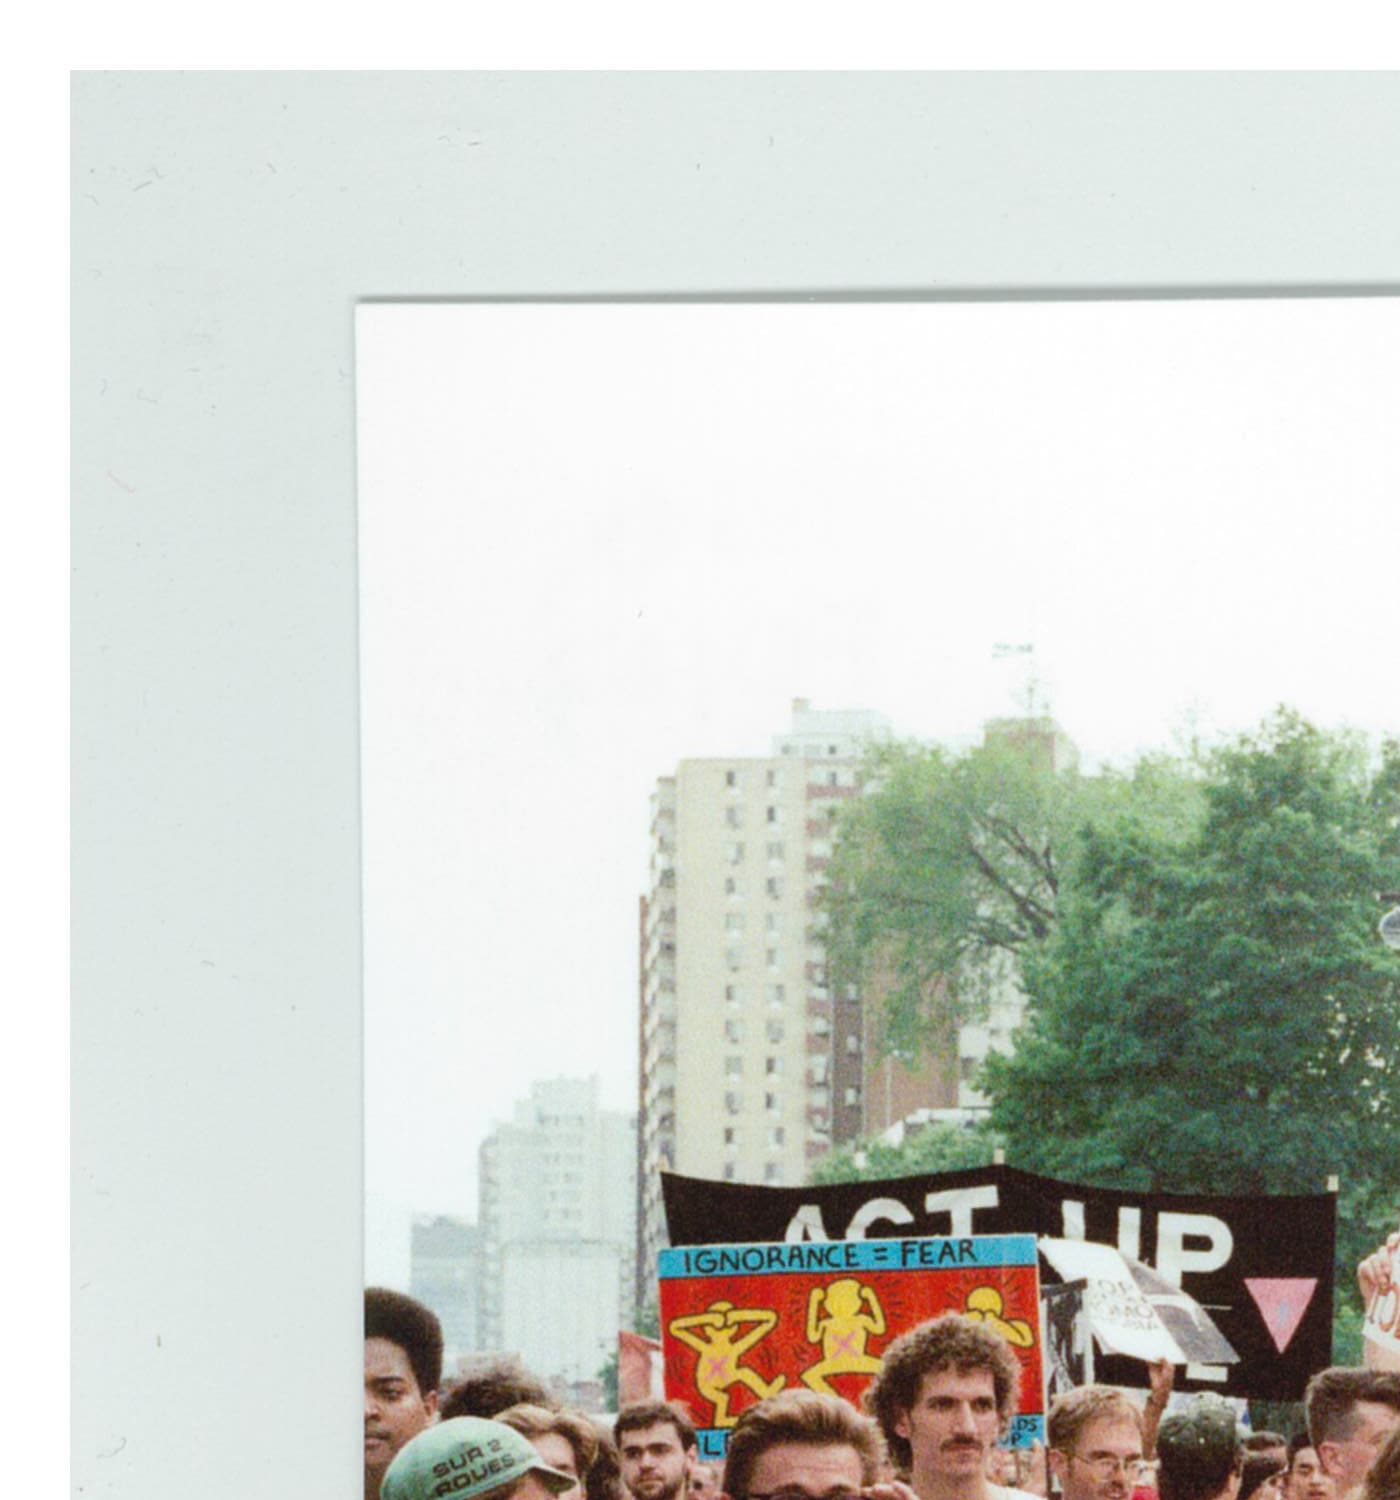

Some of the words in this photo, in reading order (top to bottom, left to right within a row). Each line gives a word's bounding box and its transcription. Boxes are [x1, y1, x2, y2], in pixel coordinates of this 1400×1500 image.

[785, 1185, 998, 1242] ACT
[684, 1243, 860, 1273] IGNORANCE
[901, 1239, 979, 1266] FEAR
[432, 1446, 483, 1478] SUR
[488, 1439, 503, 1454] 2
[435, 1454, 516, 1498] ROUES
